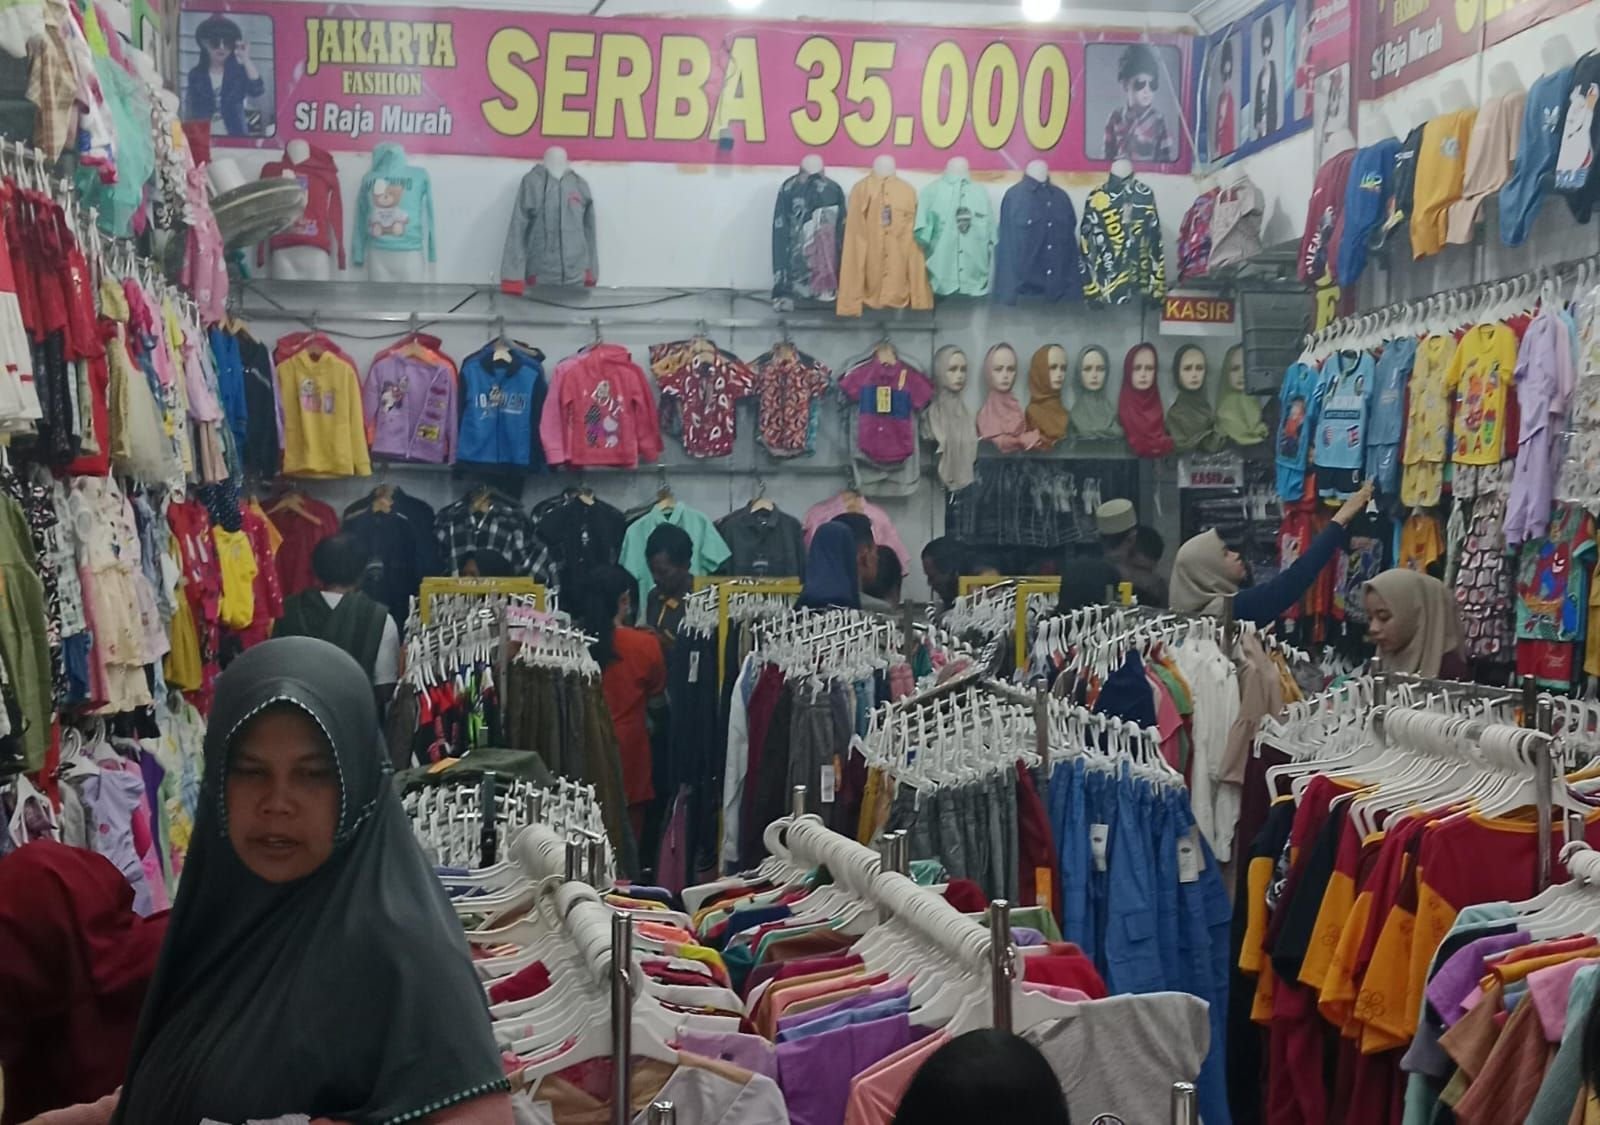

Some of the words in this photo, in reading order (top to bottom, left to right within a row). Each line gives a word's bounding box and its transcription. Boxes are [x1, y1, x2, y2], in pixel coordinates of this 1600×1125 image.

[306, 18, 457, 75] JAKARTA
[342, 70, 422, 95] FASHION
[481, 27, 766, 142] SERBA
[789, 35, 1071, 150] 35.000
[294, 101, 318, 131] Si
[323, 102, 374, 138] Raja
[380, 104, 453, 135] Murah
[1166, 299, 1230, 320] KASIR
